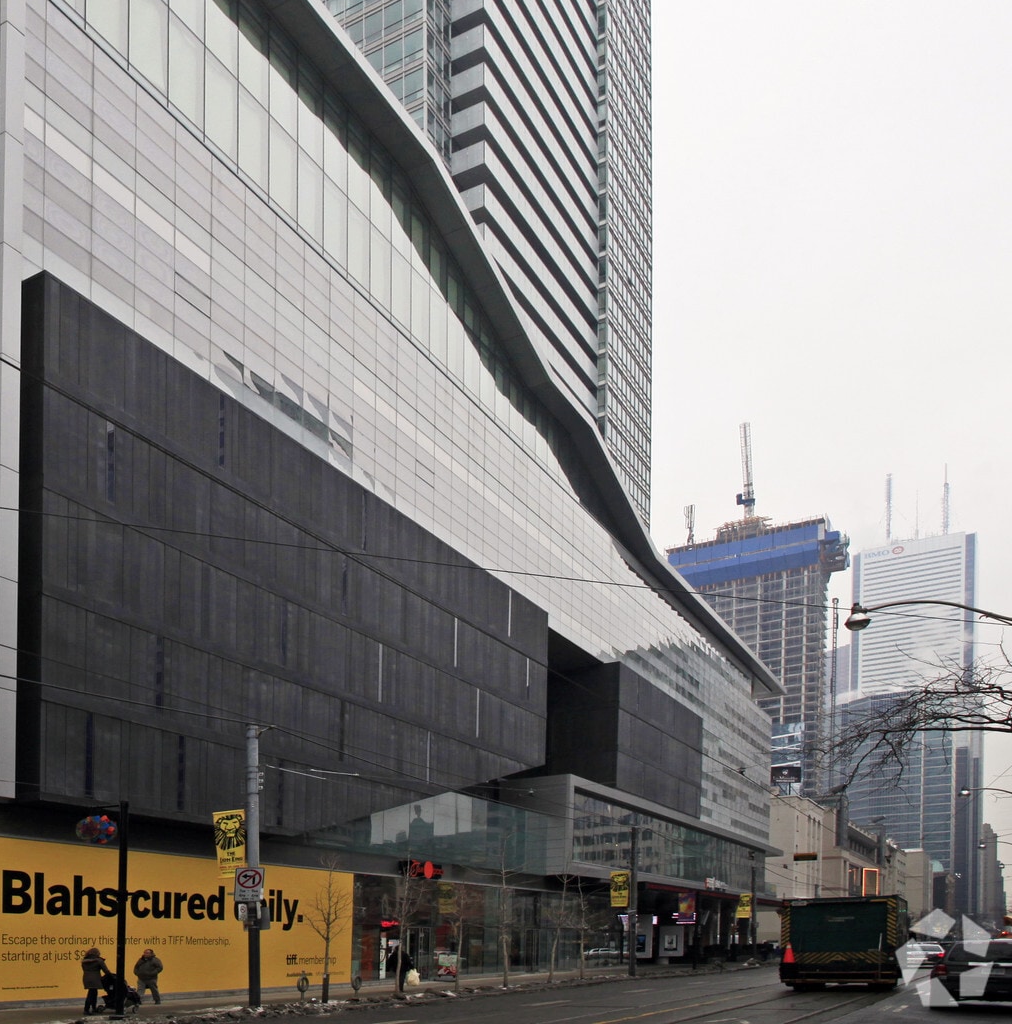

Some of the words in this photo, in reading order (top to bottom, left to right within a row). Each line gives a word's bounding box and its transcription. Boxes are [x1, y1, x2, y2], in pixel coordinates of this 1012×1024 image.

[2, 870, 119, 918] Blahs
[131, 885, 225, 921] cured
[234, 889, 303, 931] ily.
[1, 933, 38, 948] Escape
[40, 934, 57, 946] the
[58, 935, 97, 948] ordinary
[98, 935, 115, 946] this
[143, 935, 161, 946] with
[162, 938, 167, 946] a
[168, 935, 185, 946] TIFF
[1, 950, 41, 963] starting
[42, 950, 53, 961] at
[53, 950, 73, 964] just
